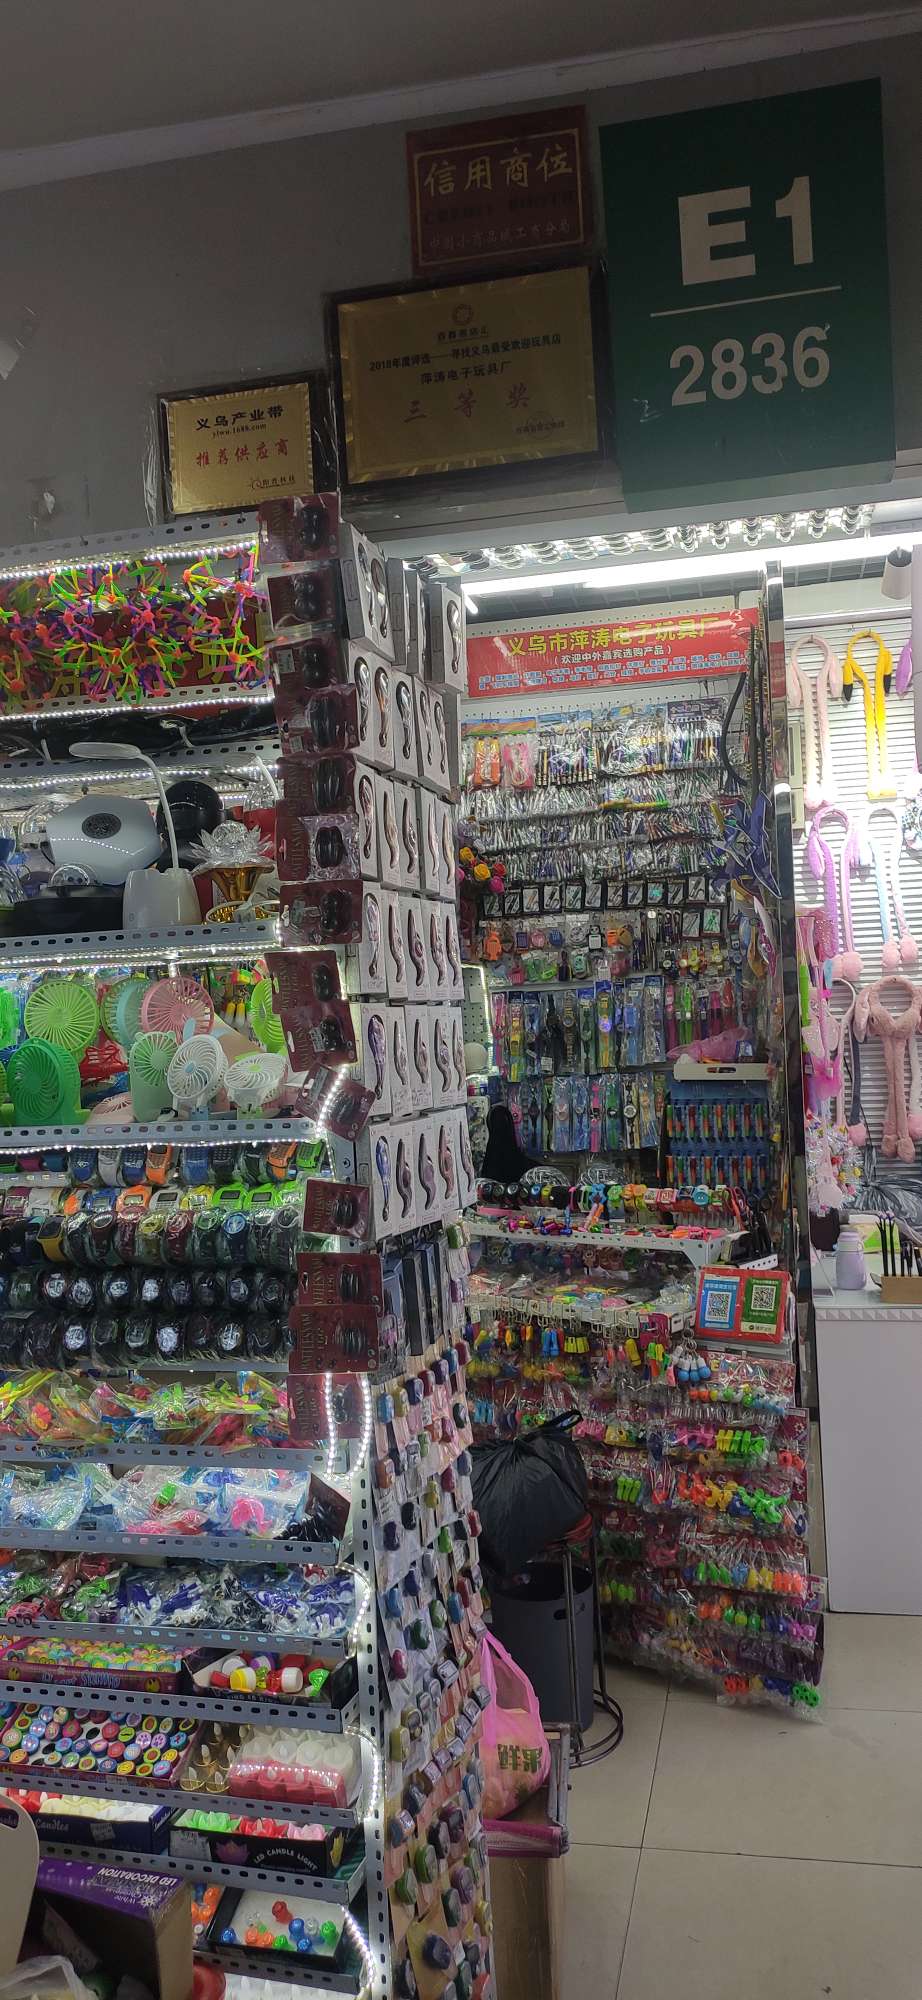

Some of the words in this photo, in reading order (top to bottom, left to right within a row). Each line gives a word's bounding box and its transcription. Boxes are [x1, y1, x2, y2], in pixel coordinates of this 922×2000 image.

[424, 144, 574, 197] 信用商位
[678, 175, 815, 286] E1
[669, 325, 831, 407] 2836
[195, 403, 284, 431] 义乌产业带
[195, 438, 290, 469] 推荐供应商
[507, 617, 721, 657] 义乌市萍涛电子玩具厂
[253, 1853, 266, 1865] LED
[266, 1848, 295, 1857] CANDLE
[96, 1867, 161, 1884] DECORATION
[159, 1877, 179, 1887] LED
